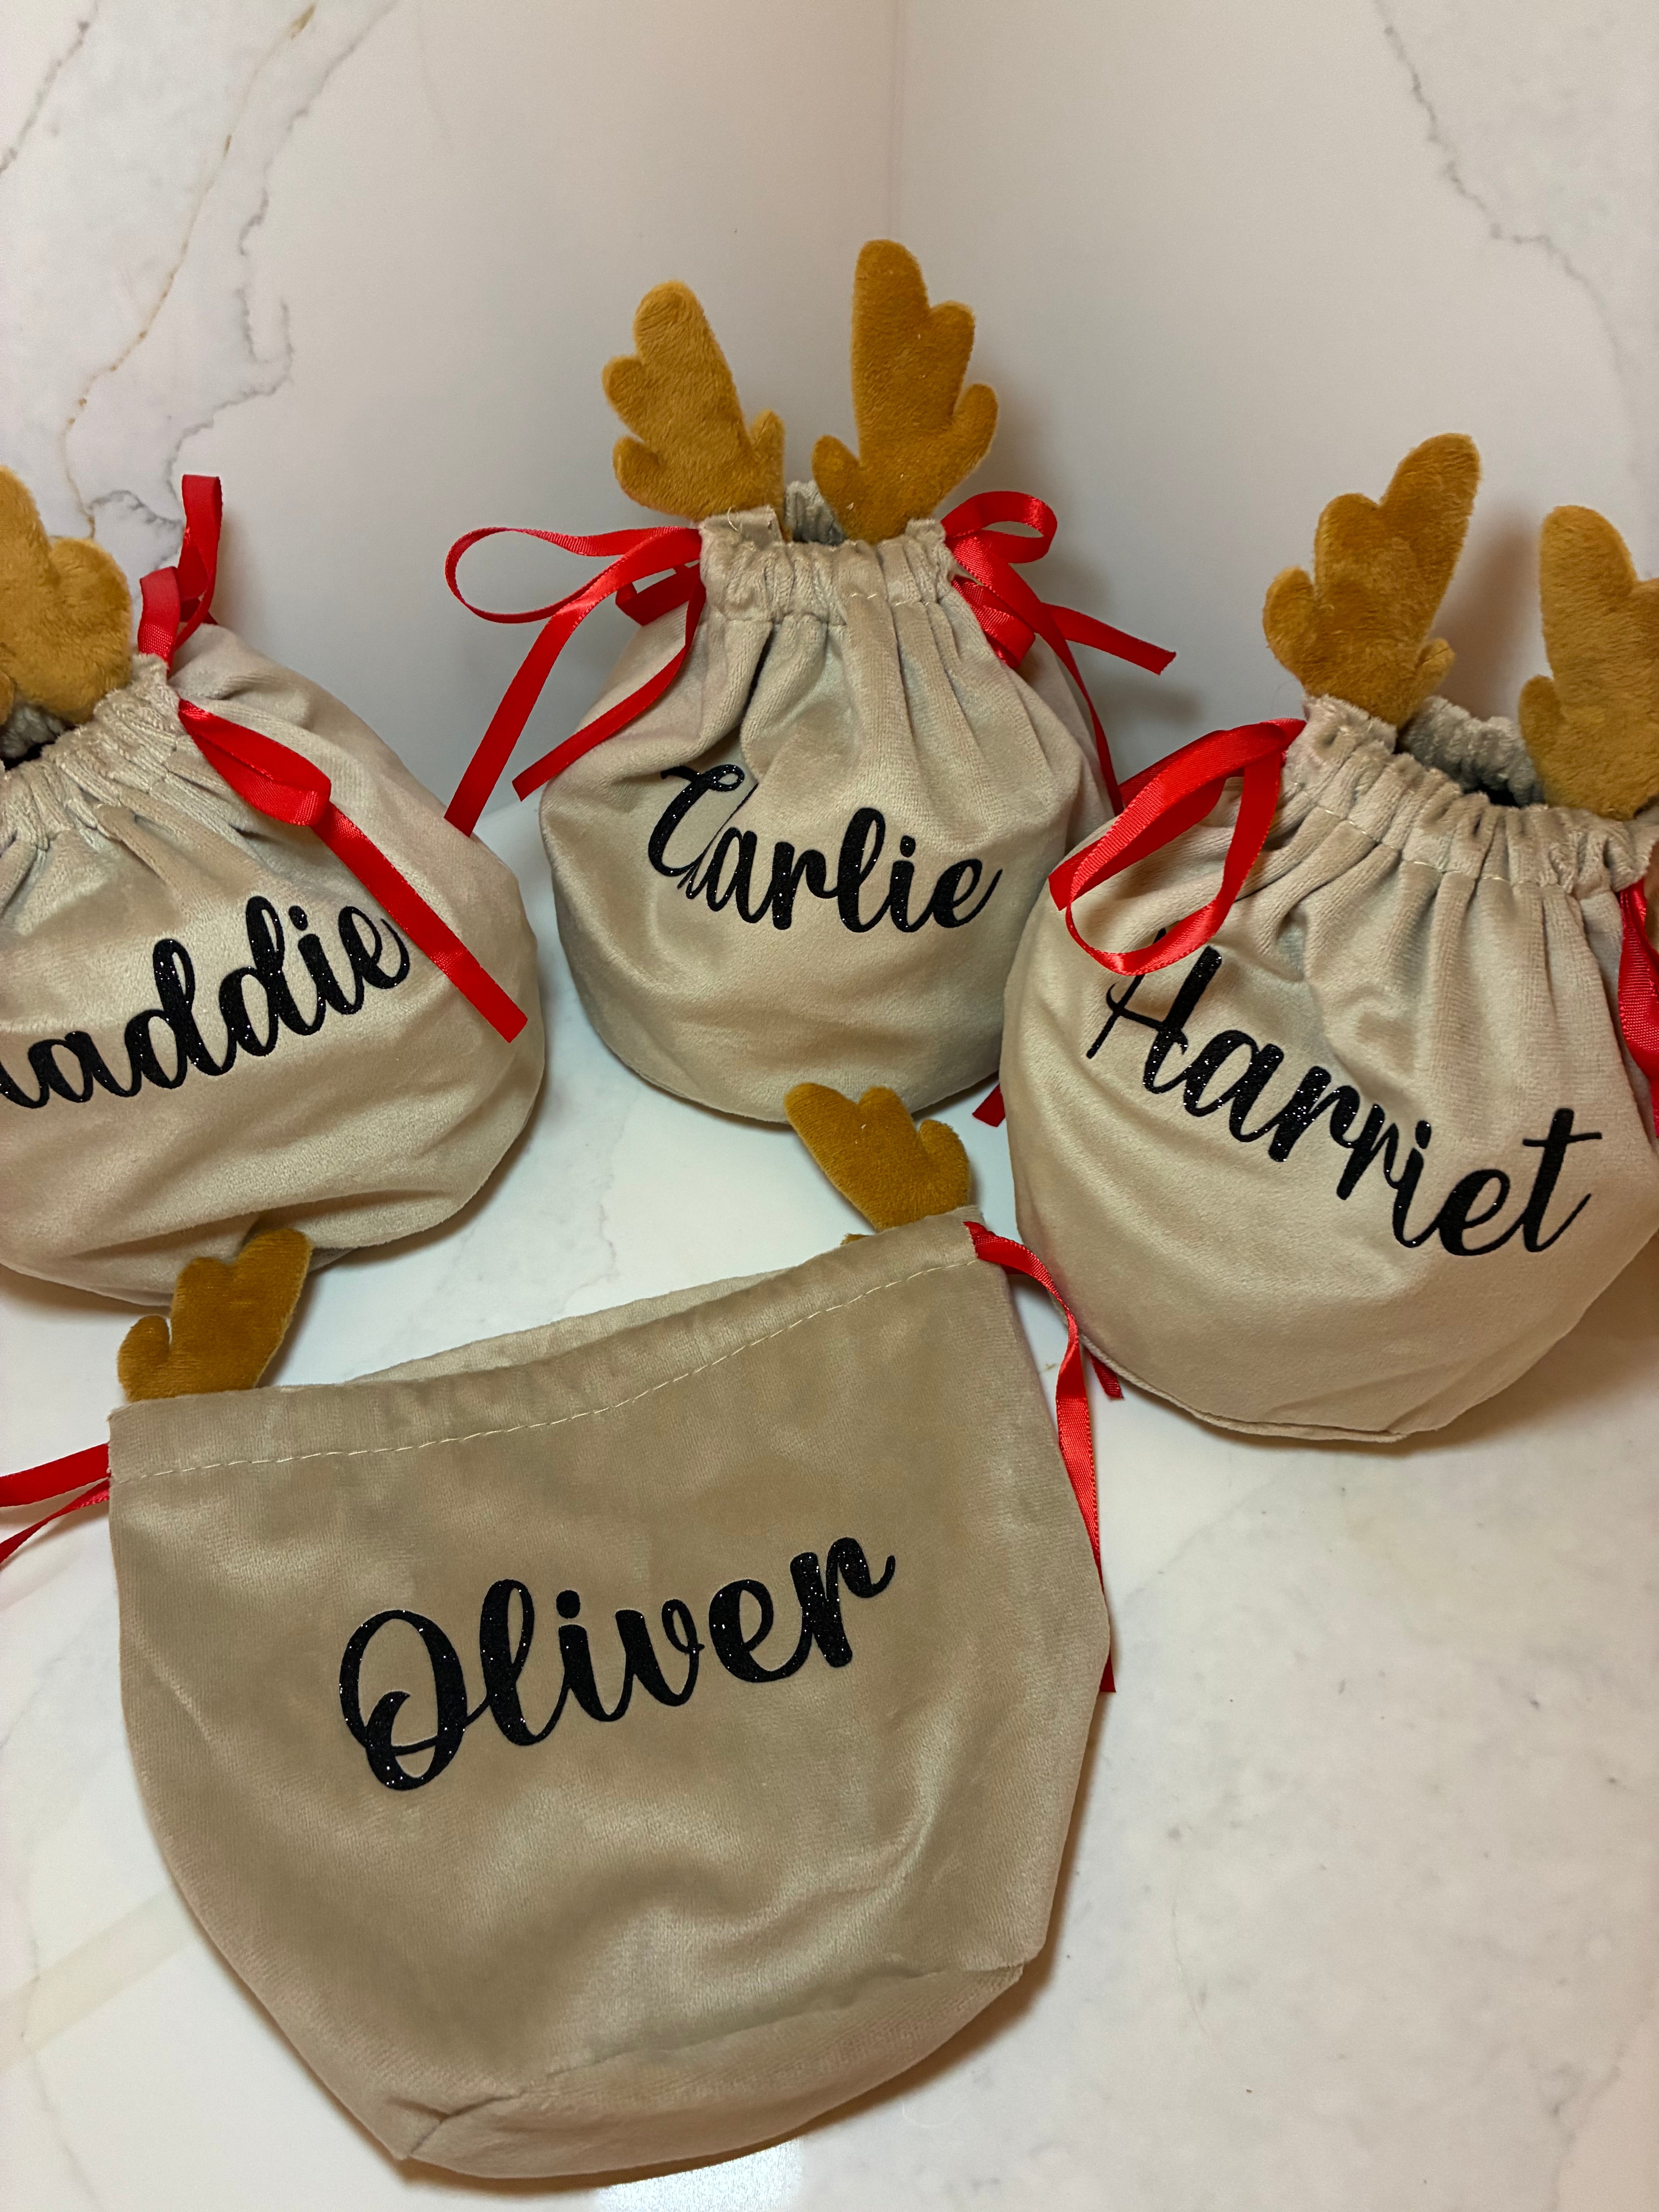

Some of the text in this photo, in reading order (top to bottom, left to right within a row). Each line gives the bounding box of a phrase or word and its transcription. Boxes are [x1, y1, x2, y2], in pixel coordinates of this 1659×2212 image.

[0, 896, 410, 1109] addie
[1085, 927, 1603, 1257] Harriet
[338, 1536, 896, 1792] Oliver
